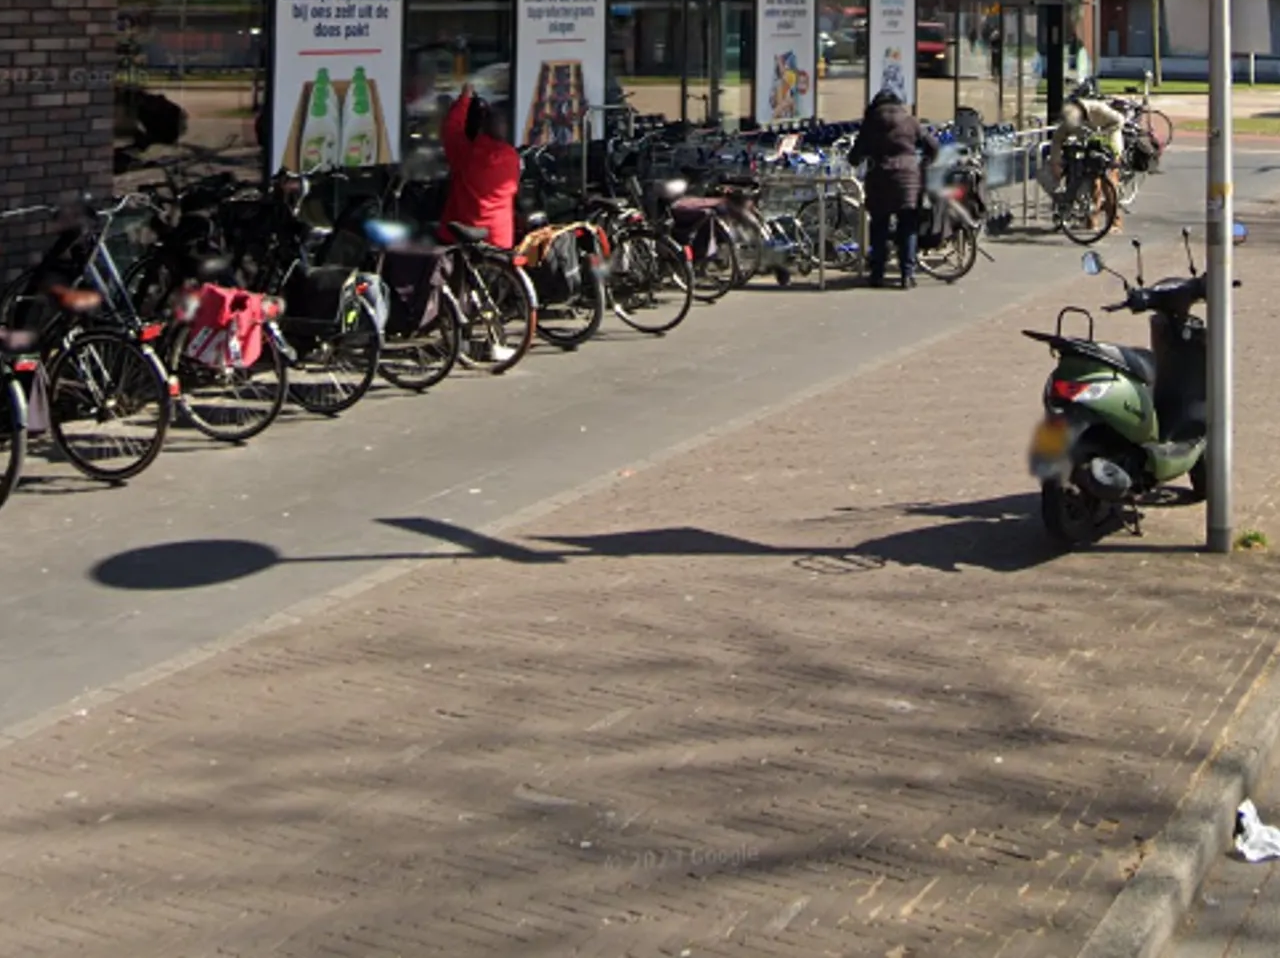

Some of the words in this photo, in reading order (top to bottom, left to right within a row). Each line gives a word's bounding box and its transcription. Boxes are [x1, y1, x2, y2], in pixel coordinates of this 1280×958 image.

[292, 3, 308, 22] bij
[310, 6, 332, 18] ons
[334, 4, 356, 18] zelf
[358, 4, 373, 18] uit
[375, 4, 389, 18] de
[313, 23, 341, 37] doos
